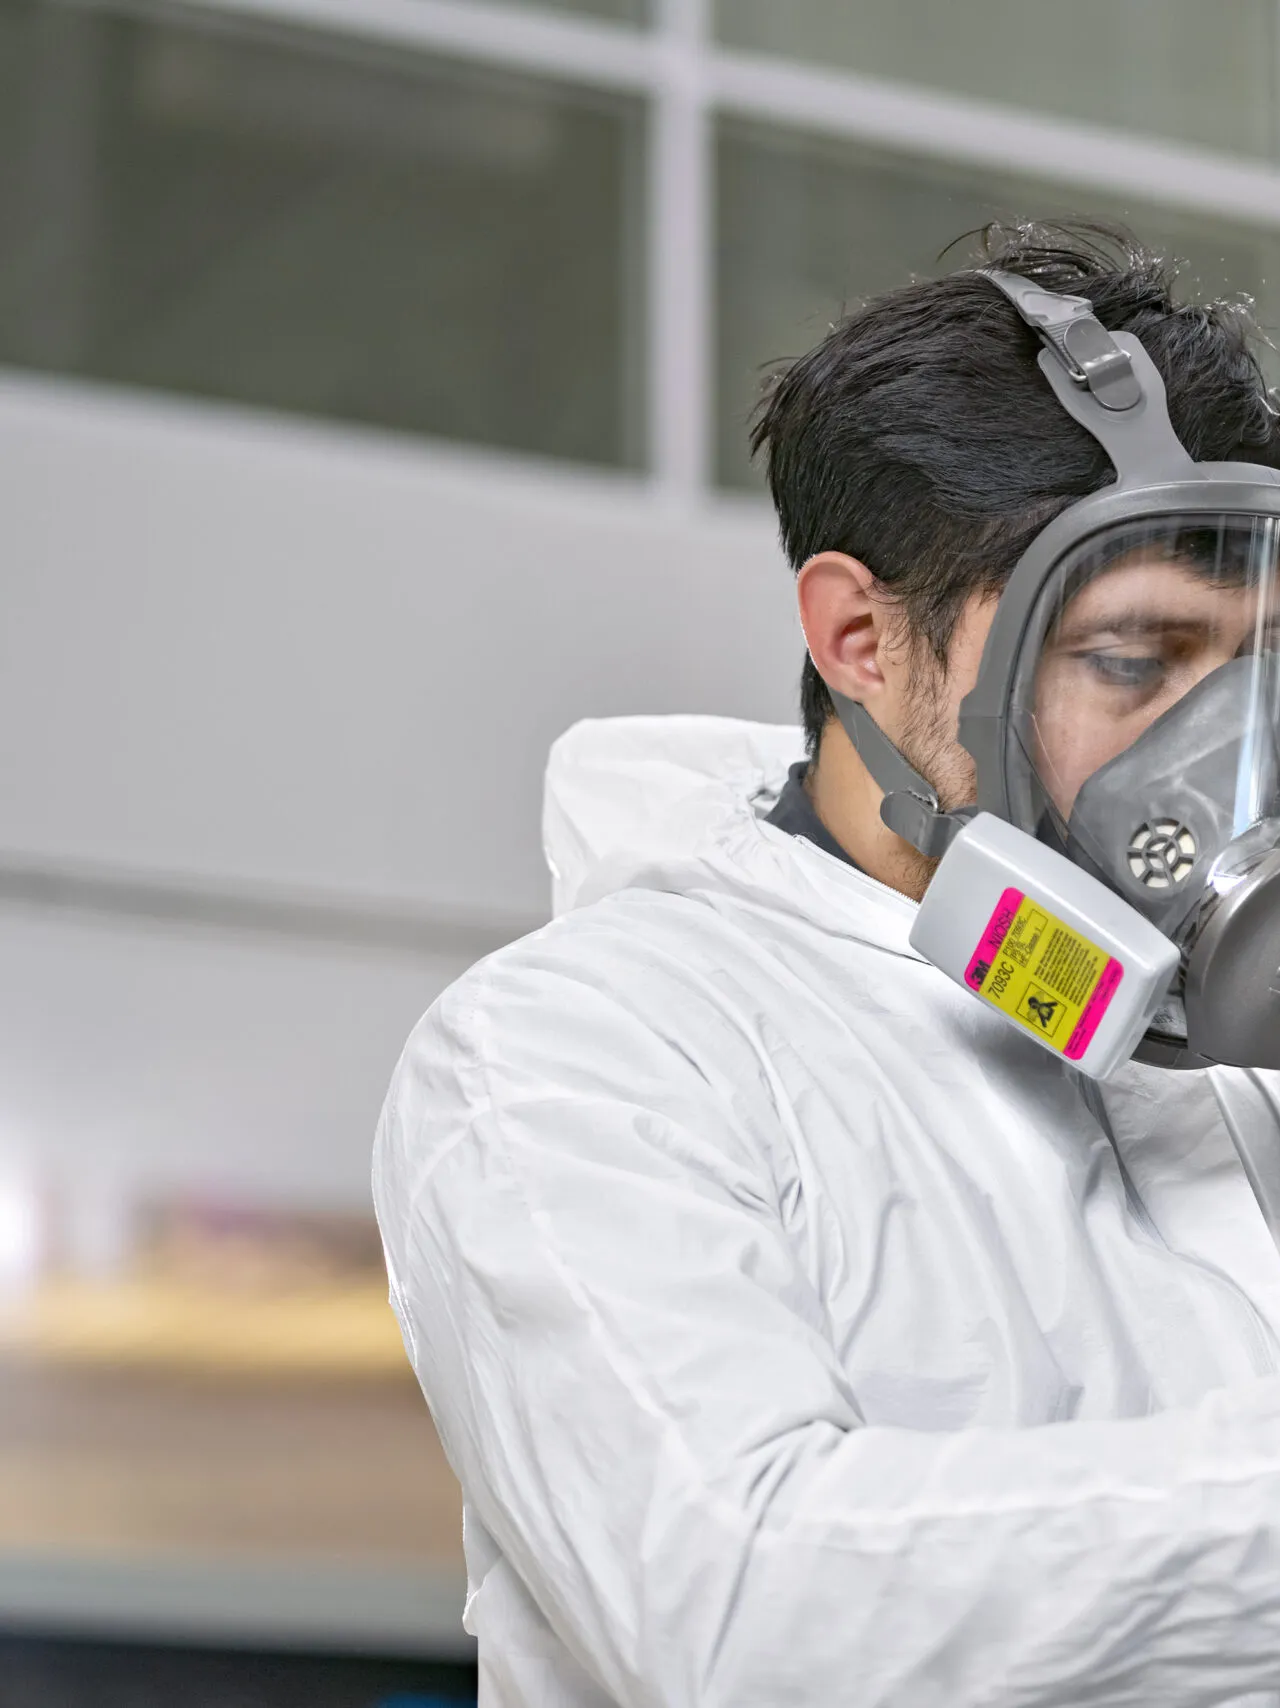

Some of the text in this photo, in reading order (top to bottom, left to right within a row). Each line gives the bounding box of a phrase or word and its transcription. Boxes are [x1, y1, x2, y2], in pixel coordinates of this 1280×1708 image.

[971, 907, 1014, 985] 3M NIOSH
[988, 961, 1015, 1000] 7093C
